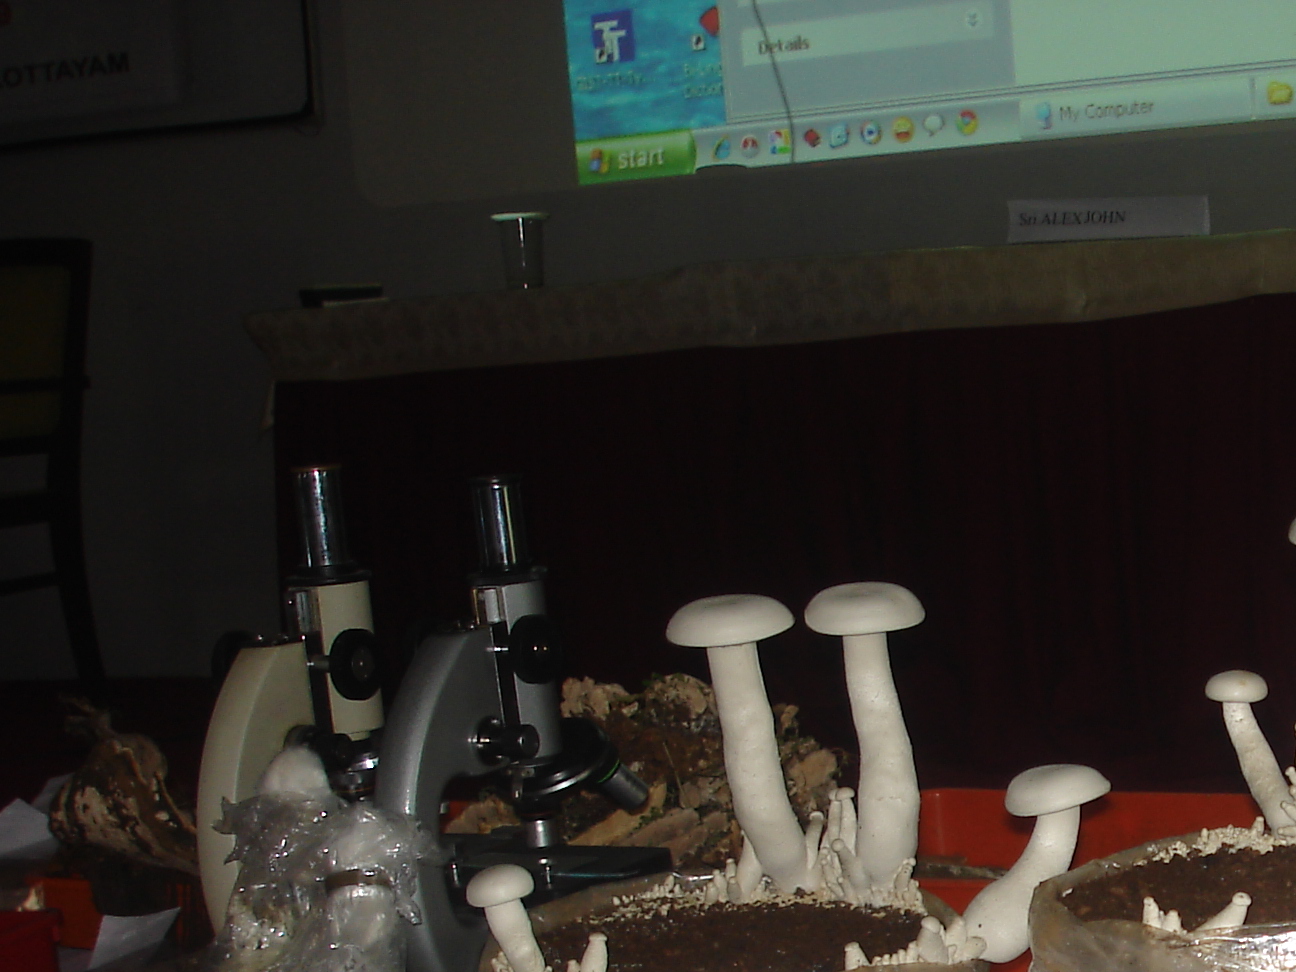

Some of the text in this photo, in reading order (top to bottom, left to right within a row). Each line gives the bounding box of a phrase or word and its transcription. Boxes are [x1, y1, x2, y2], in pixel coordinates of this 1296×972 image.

[758, 35, 810, 55] Details
[0, 51, 130, 89] OTTAYAM
[1059, 99, 1155, 122] My Computer
[618, 149, 664, 170] start
